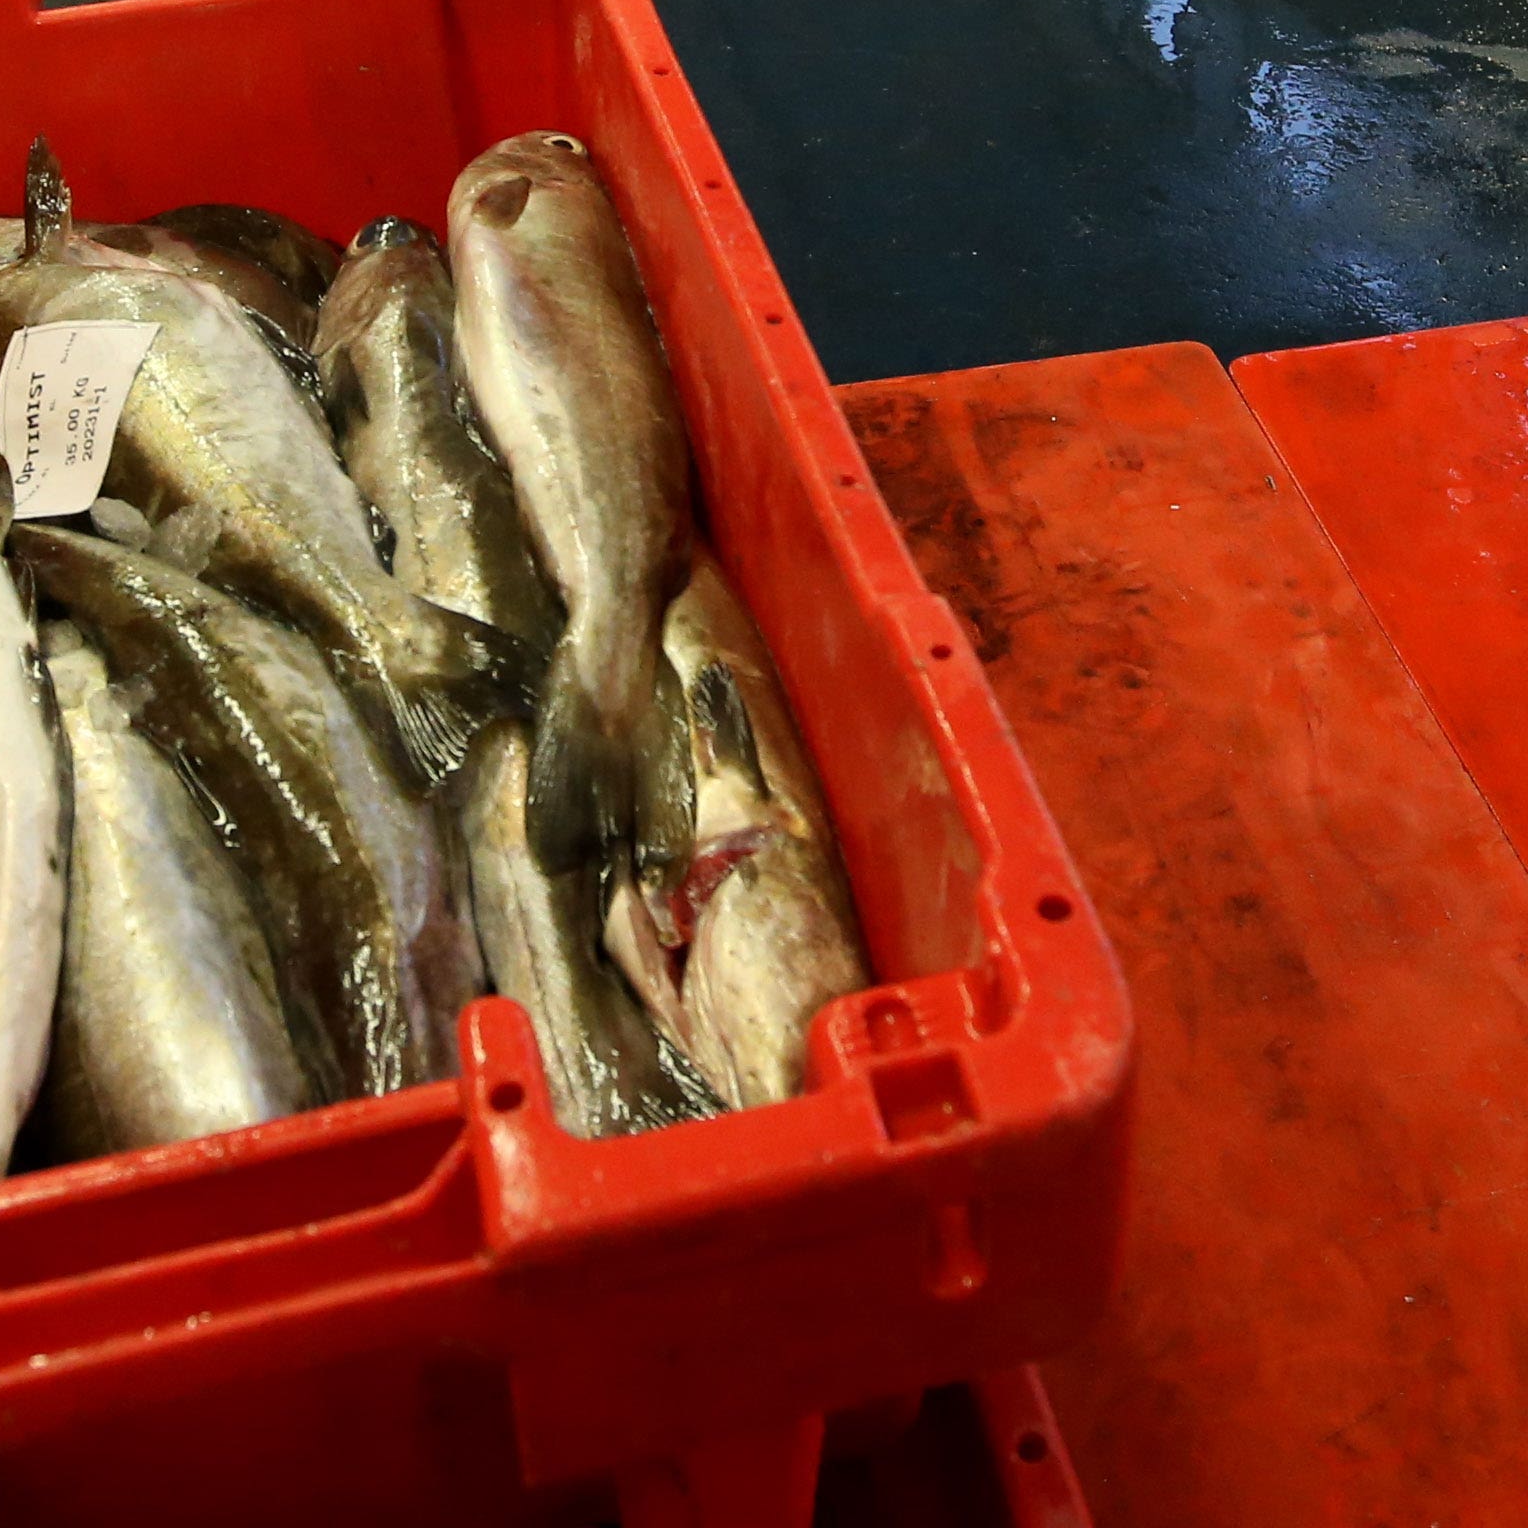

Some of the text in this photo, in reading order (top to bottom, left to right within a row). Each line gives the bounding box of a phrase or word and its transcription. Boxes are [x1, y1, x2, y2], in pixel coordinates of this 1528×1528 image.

[15, 371, 46, 486] OPTIMIST
[65, 376, 90, 466] 35.00 KG
[82, 384, 108, 463] 20231-1
